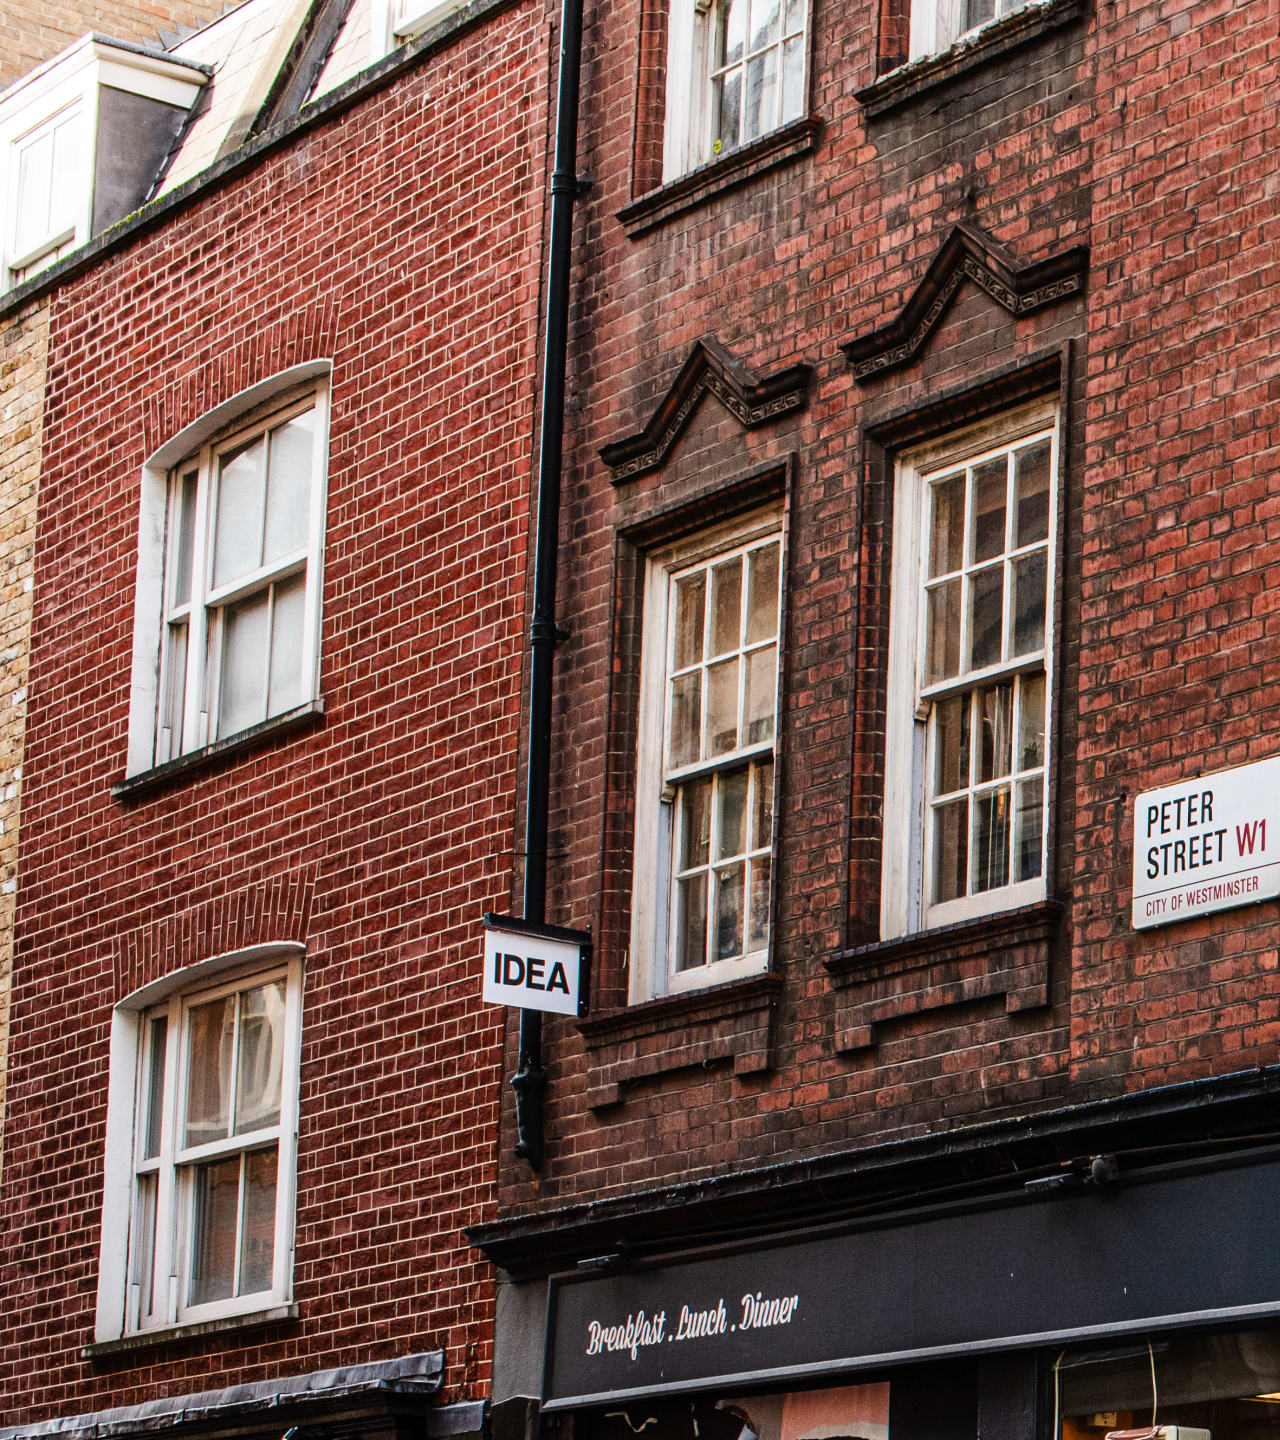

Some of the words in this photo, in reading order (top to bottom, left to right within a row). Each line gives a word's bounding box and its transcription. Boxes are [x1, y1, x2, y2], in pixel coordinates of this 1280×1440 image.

[1147, 790, 1214, 838] PETER
[1147, 828, 1227, 879] STREET
[1236, 818, 1266, 857] W1
[1146, 897, 1167, 916] CITY
[1171, 893, 1183, 910] OF
[1186, 875, 1259, 907] WESTMINSTER
[494, 951, 570, 995] IDEA
[586, 1310, 667, 1360] Breakfast
[676, 1298, 728, 1341] Lunch
[739, 1291, 798, 1330] Dinner
